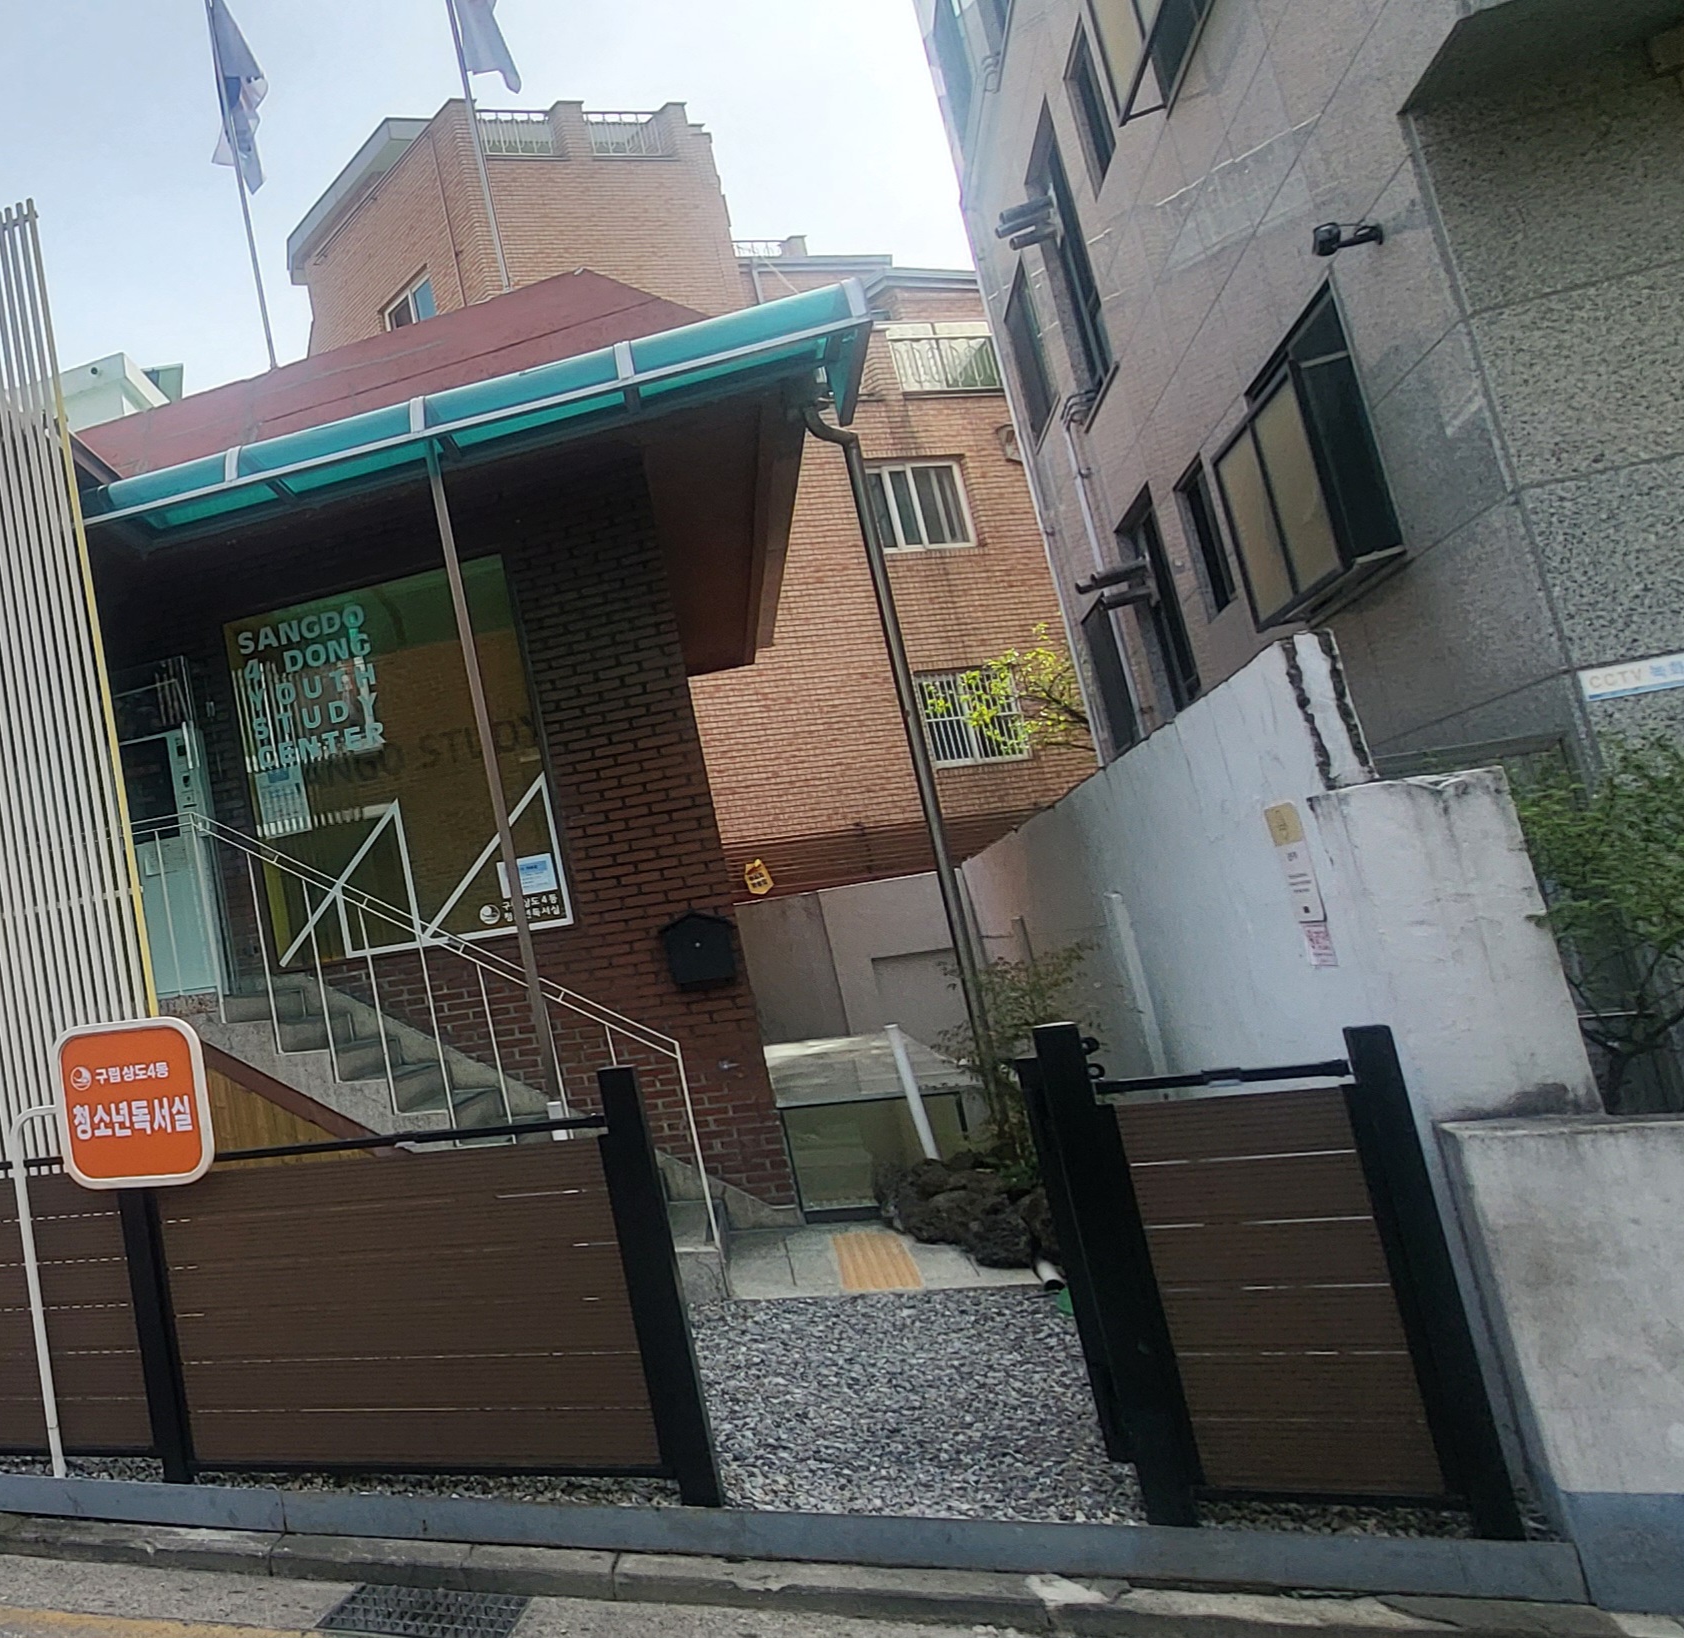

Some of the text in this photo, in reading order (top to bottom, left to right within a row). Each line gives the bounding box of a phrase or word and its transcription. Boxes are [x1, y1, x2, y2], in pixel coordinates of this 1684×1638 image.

[237, 605, 364, 655] SANGDO
[244, 633, 371, 682] 4 DONG
[1589, 668, 1642, 689] CCTV
[248, 663, 376, 711] YOUTH
[253, 692, 377, 740] STUDY
[258, 722, 386, 768] CENTER
[73, 1095, 193, 1140] 청소년독서실
